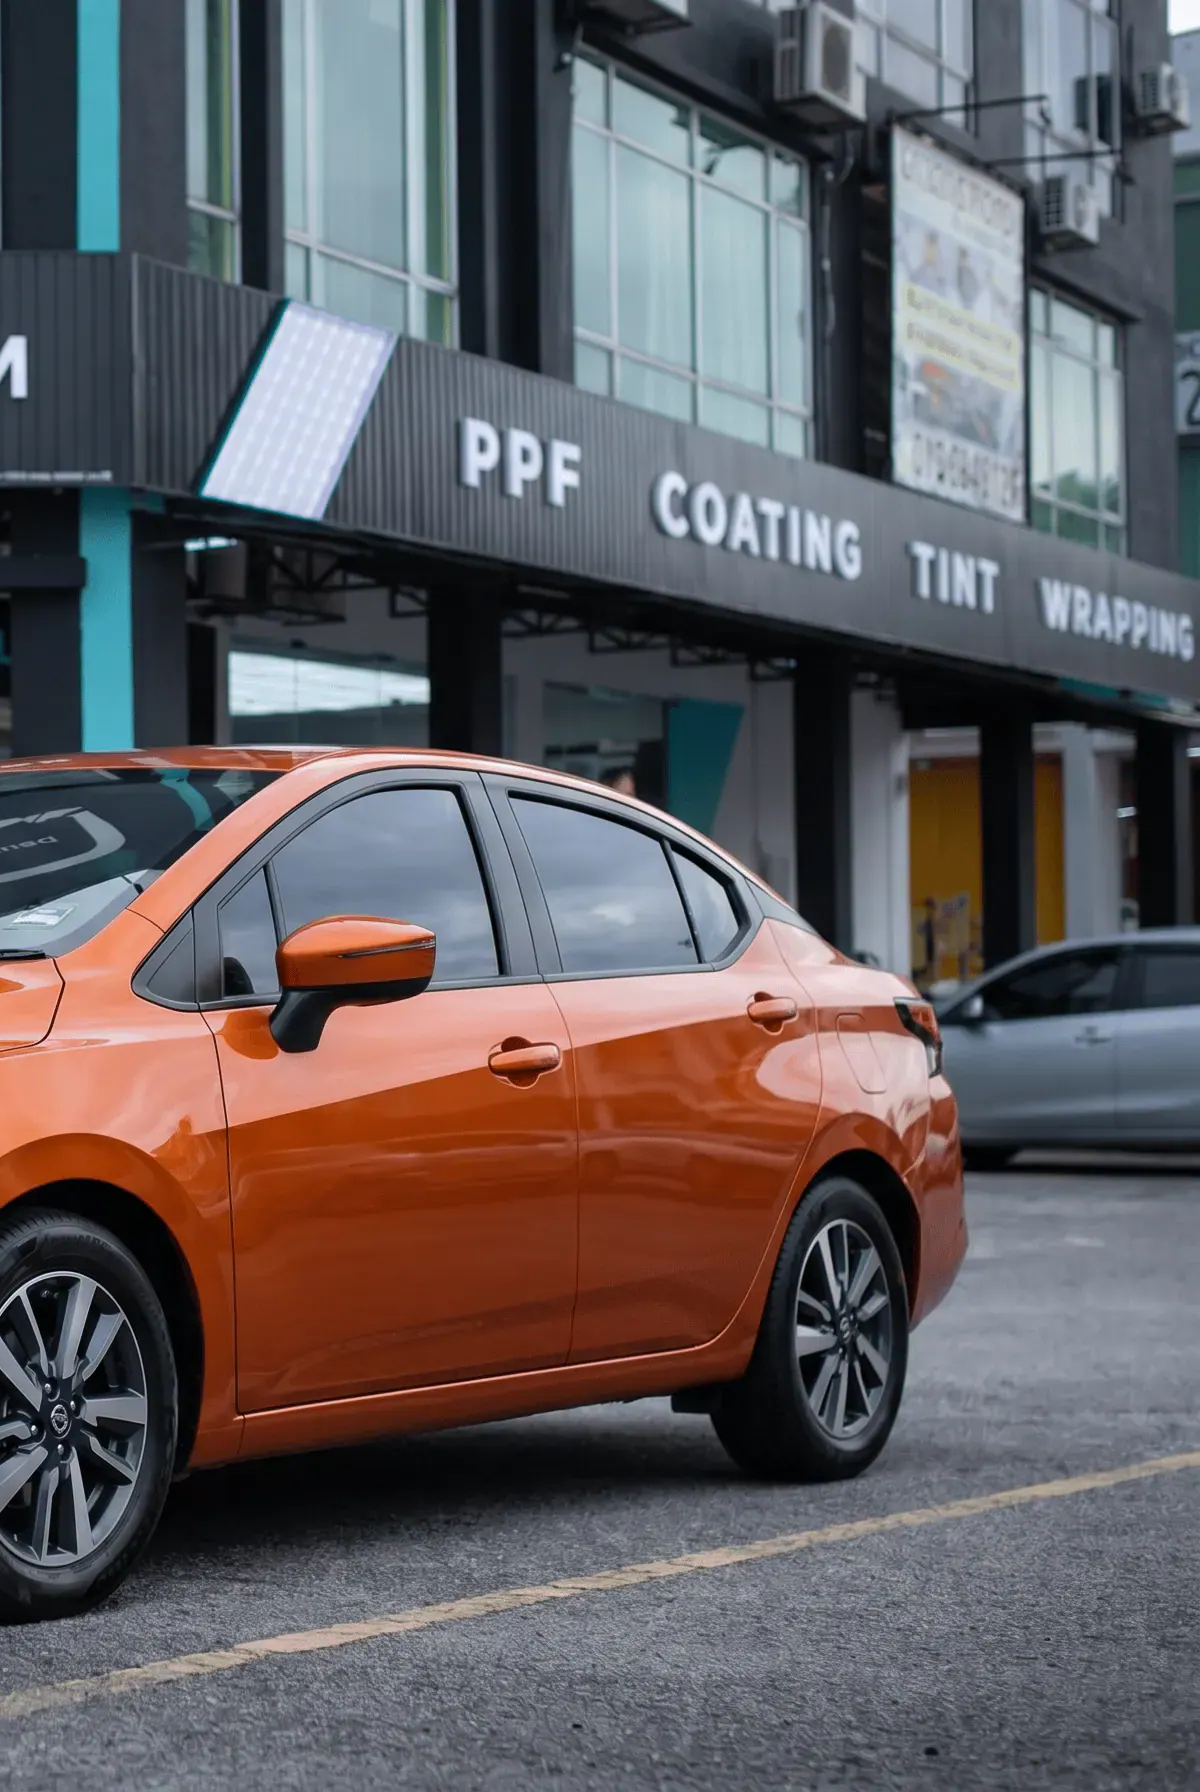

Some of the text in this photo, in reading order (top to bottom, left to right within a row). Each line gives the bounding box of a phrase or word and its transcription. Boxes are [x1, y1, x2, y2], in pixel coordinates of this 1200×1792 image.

[459, 416, 1195, 662] PPF COATING TINT WRAPPING
